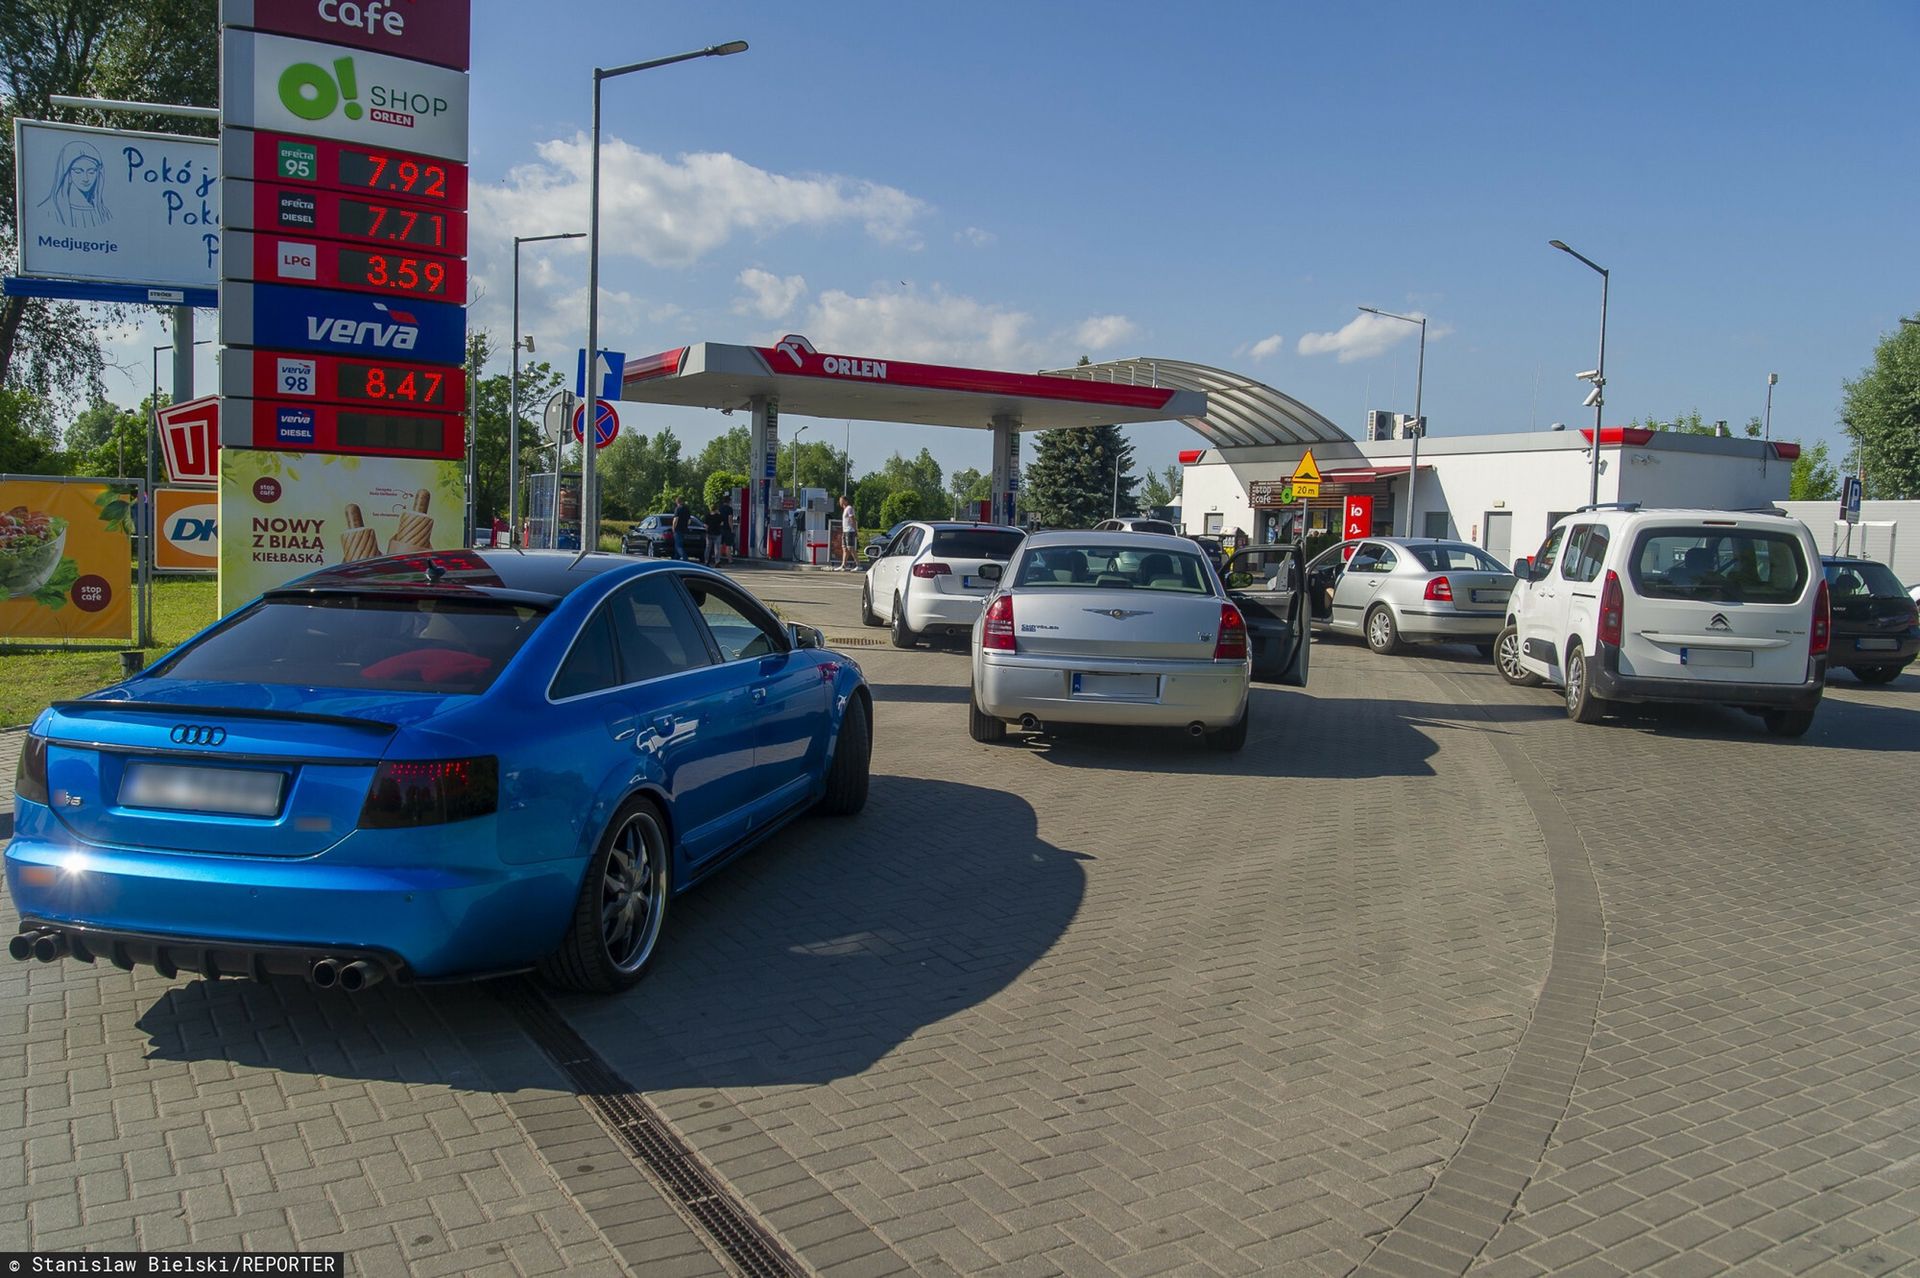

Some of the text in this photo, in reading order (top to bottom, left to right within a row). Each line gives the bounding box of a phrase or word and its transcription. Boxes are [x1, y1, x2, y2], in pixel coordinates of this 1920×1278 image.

[278, 56, 448, 120] O! SHOP
[372, 110, 413, 127] ORLEN
[122, 146, 218, 198] Pokój
[285, 159, 310, 178] 95
[367, 156, 446, 198] 7.92
[281, 212, 314, 224] DIESEL
[368, 205, 443, 247] 7.71
[38, 235, 118, 254] Medjugorje
[284, 255, 311, 267] LPG
[367, 255, 445, 292] 3.59
[307, 316, 419, 350] verva
[281, 366, 312, 376] verva
[823, 356, 887, 379] ORLEN
[284, 376, 308, 392] 98
[366, 368, 443, 402] 8.47
[280, 414, 311, 424] verva
[280, 428, 312, 438] DIESEL
[1297, 486, 1307, 494] 20
[1852, 484, 1859, 507] P
[252, 517, 325, 534] NOWY
[252, 535, 325, 553] Z BIAŁĄ
[252, 552, 324, 565] KIEŁBASKĄ
[81, 586, 102, 594] stop
